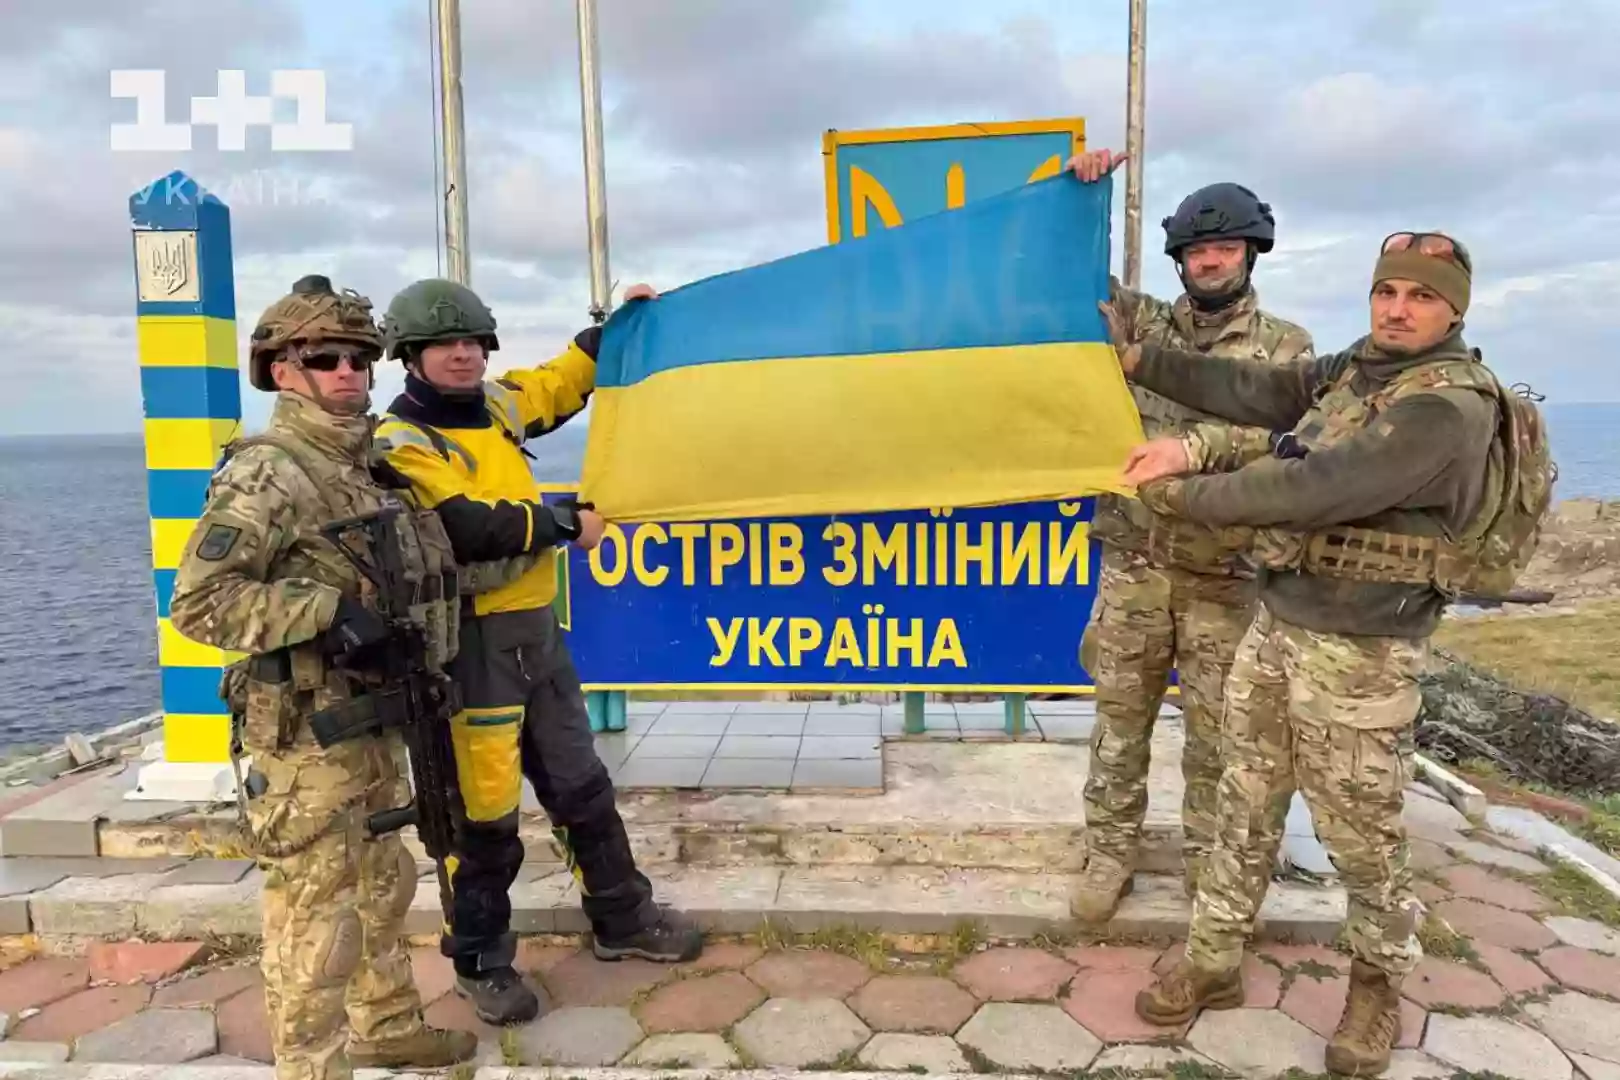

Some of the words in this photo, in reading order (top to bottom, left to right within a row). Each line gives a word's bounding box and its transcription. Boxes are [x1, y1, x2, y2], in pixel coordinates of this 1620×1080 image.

[588, 521, 805, 586] ОСТРІВ
[821, 501, 1090, 586] ЗМІЇНИЙ
[706, 604, 967, 668] УКРАЇНА
